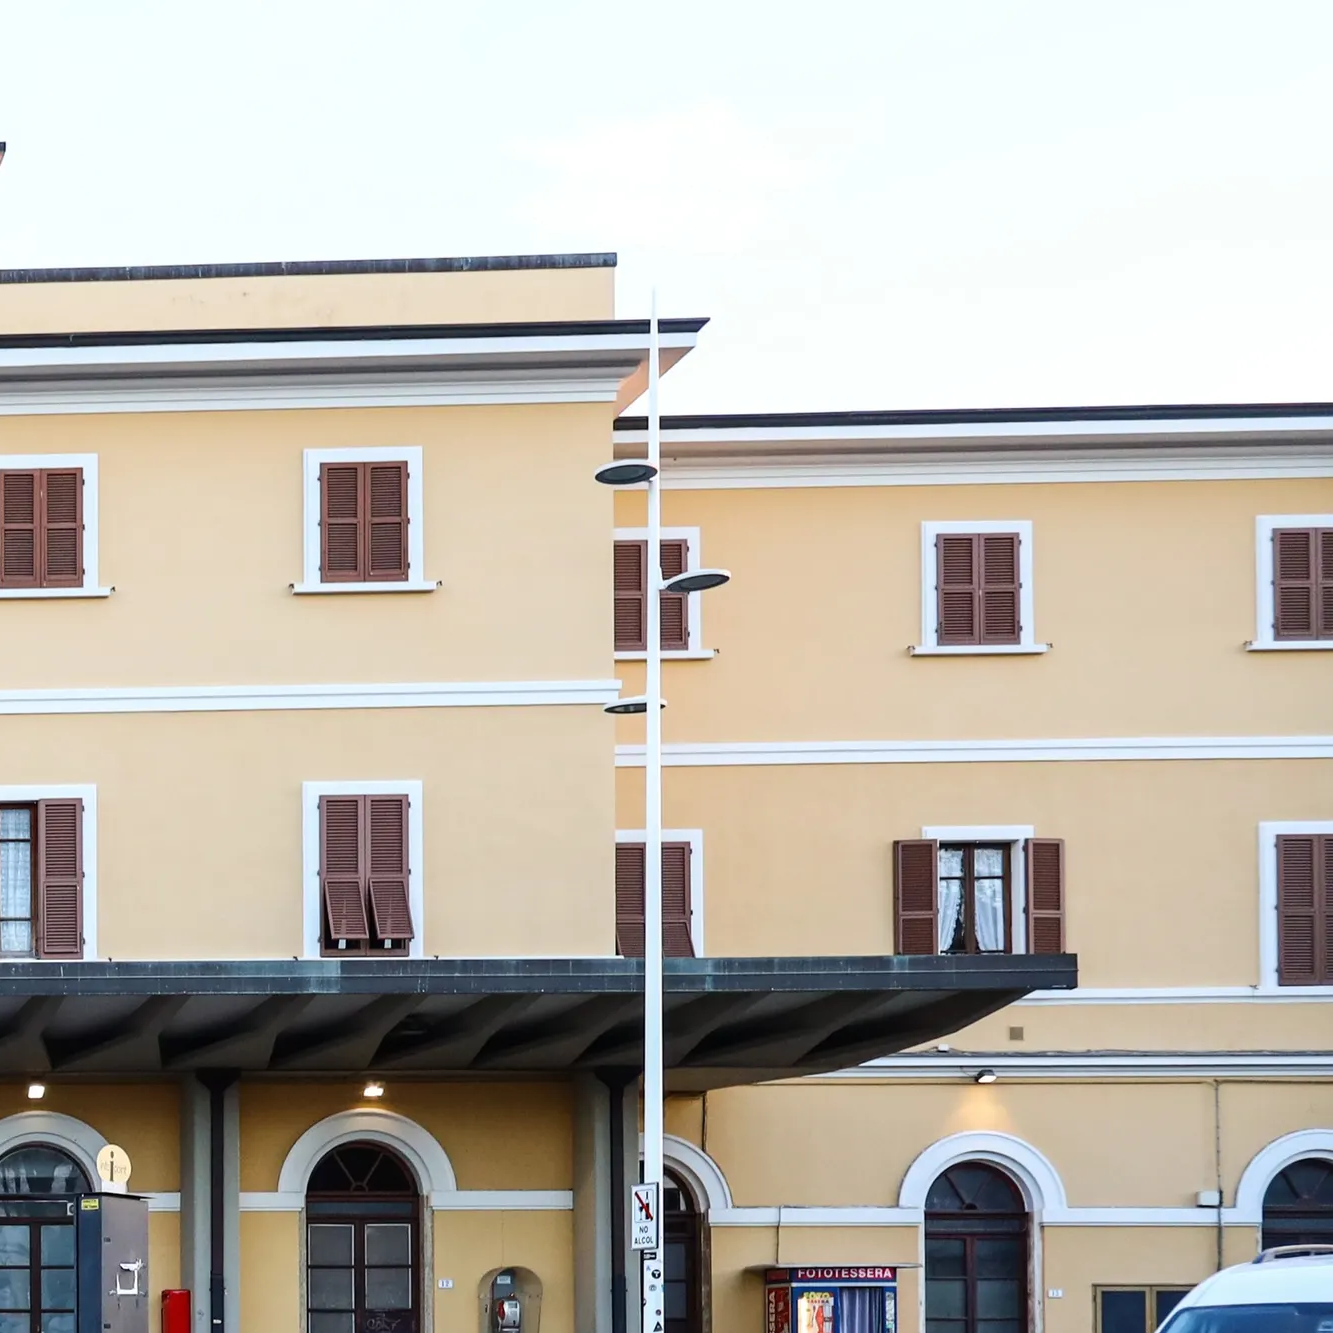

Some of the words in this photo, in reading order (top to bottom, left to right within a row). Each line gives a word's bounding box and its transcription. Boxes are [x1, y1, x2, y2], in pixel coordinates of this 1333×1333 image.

[639, 1226, 649, 1234] NO
[634, 1235, 654, 1245] ALCOL
[797, 1267, 893, 1279] FOTOTESSERA
